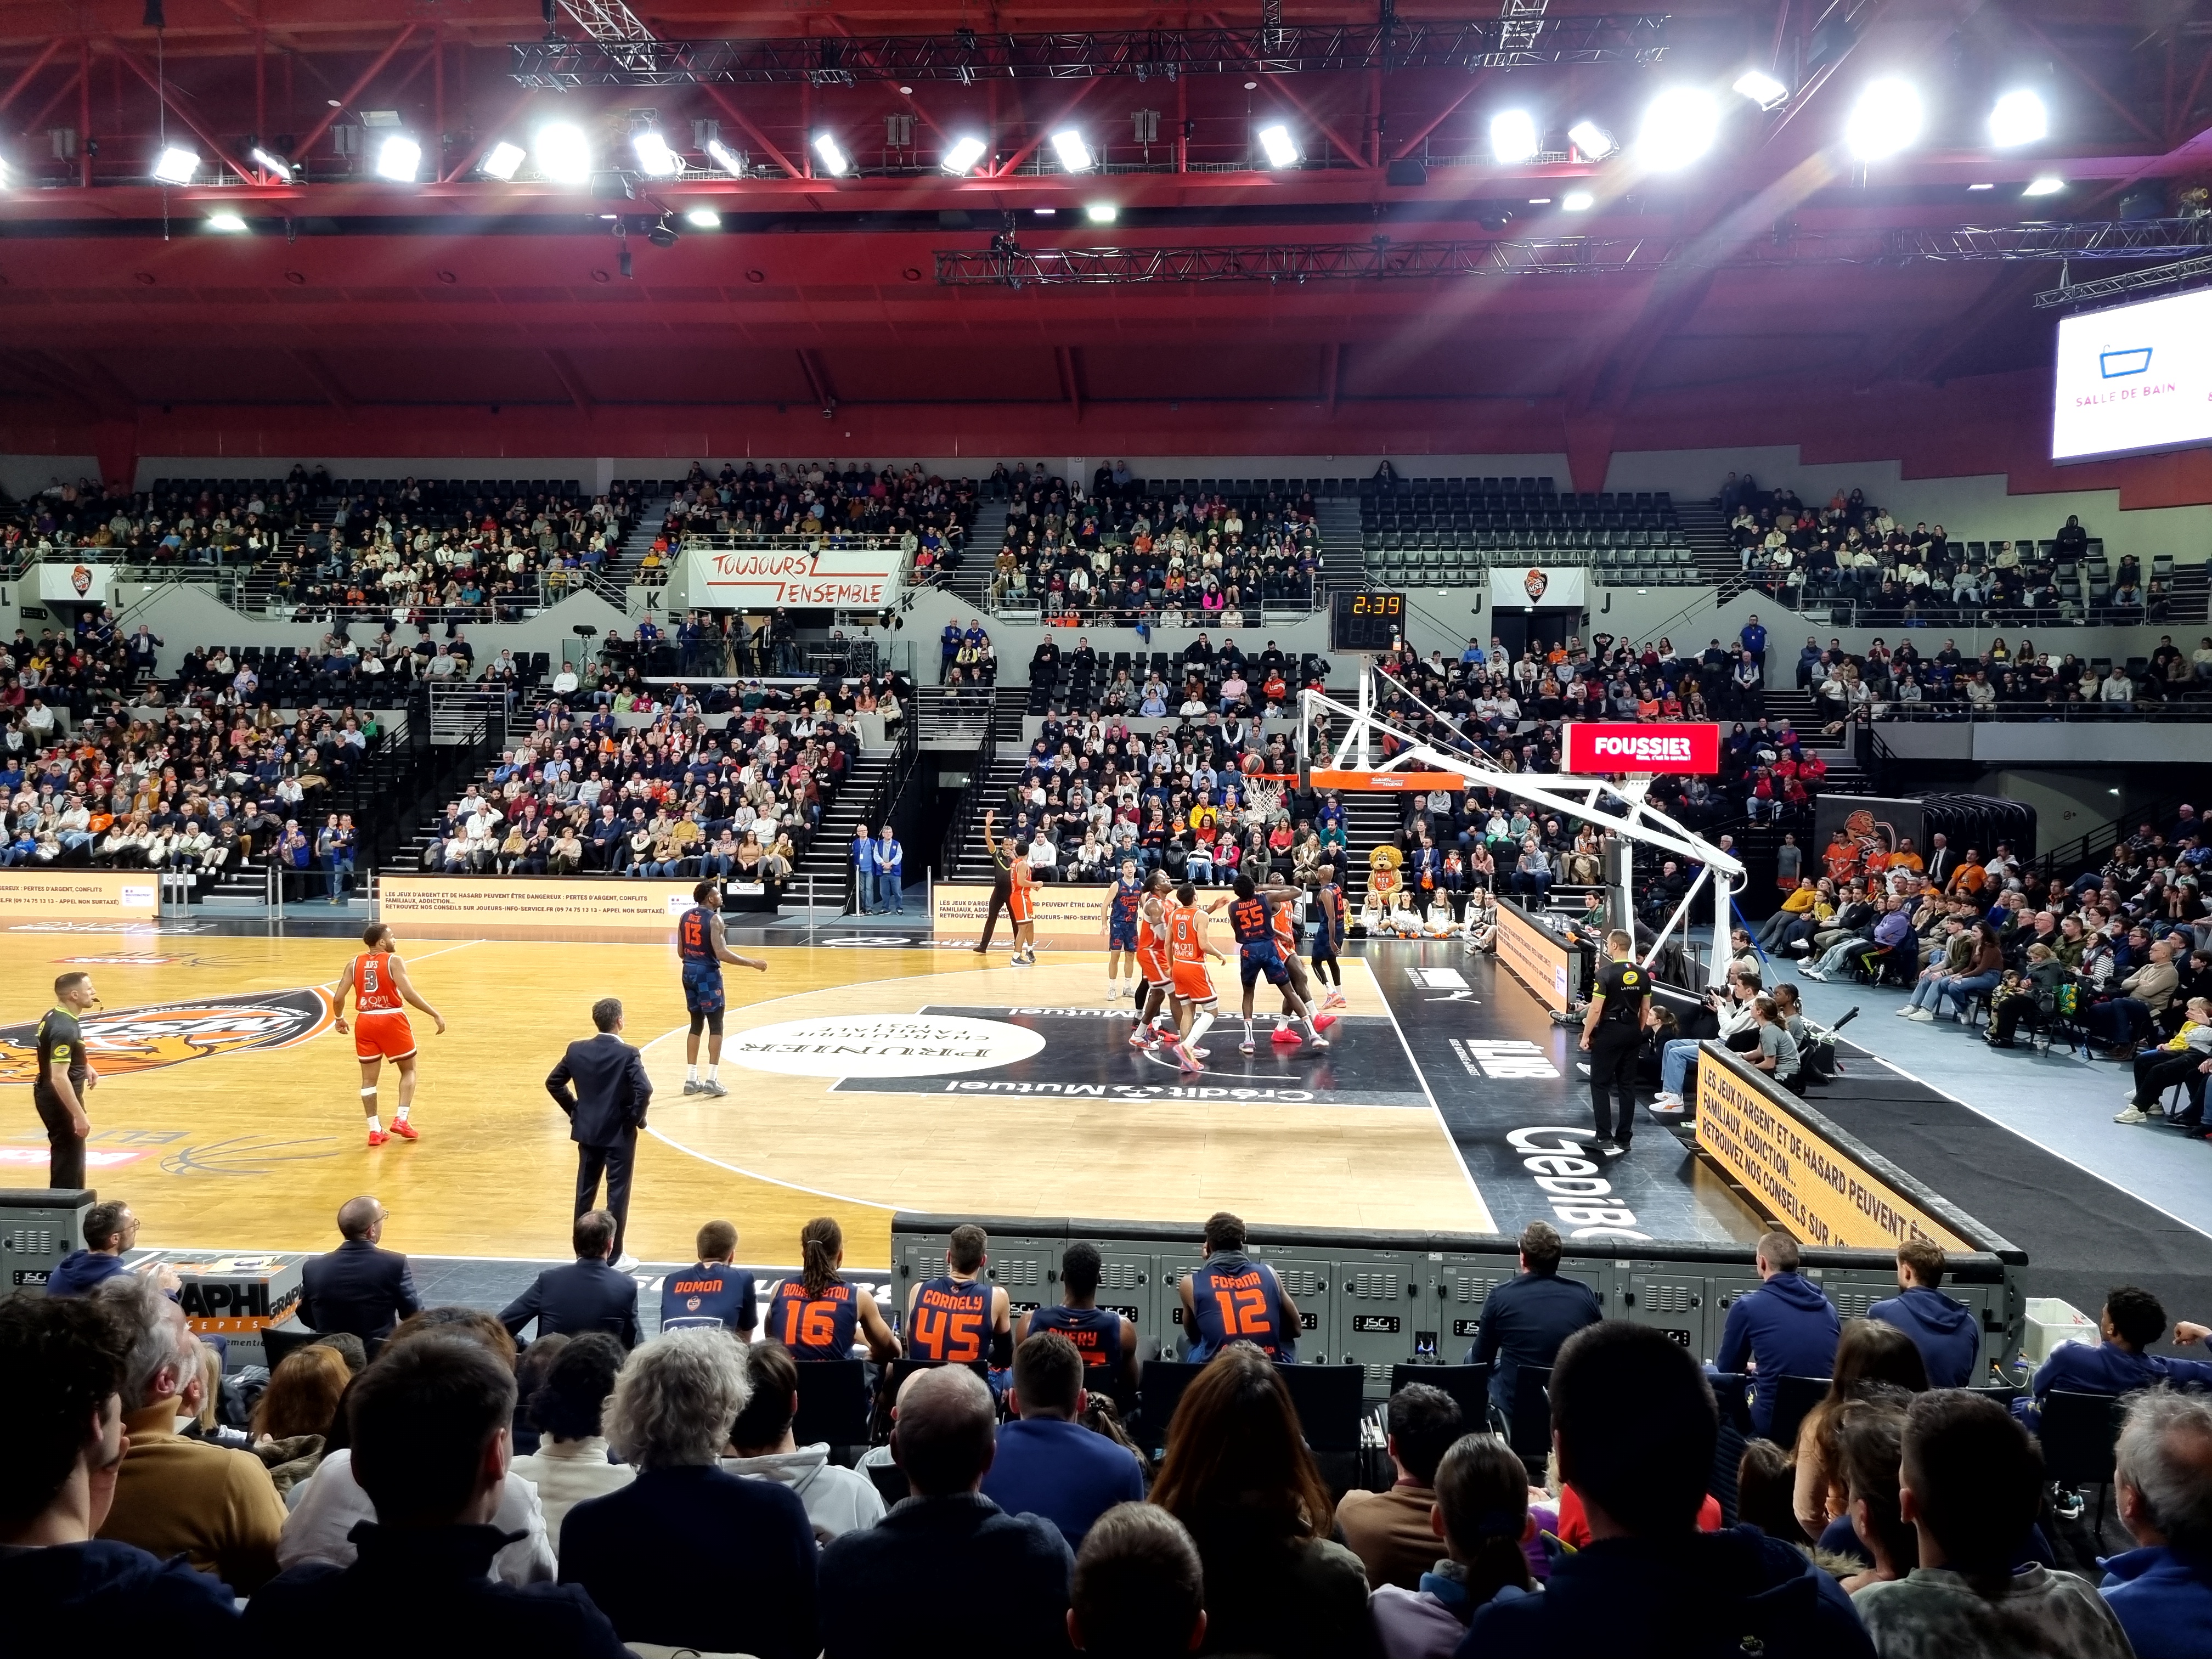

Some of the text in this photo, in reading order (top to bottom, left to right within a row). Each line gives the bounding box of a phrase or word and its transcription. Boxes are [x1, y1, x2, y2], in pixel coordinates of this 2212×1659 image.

[2076, 382, 2175, 407] SALLE DE BAIN
[712, 554, 808, 579] TOUJOURS
[76, 577, 89, 586] MSB
[1528, 582, 1544, 592] MSB
[1, 587, 10, 606] L
[115, 588, 124, 608] L
[647, 591, 661, 609] K
[788, 583, 884, 605] ENSEMBLE
[901, 592, 915, 612] K
[1471, 594, 1481, 614] J
[1600, 592, 1611, 614] J
[1354, 596, 1399, 613] 2:39
[1595, 737, 1691, 754] FOUSSIER
[1235, 905, 1264, 929] 35
[685, 922, 702, 945] 13
[1178, 922, 1186, 940] 9
[364, 970, 378, 992] 3
[792, 1031, 990, 1041] CHARCUTERIE
[821, 1026, 968, 1036] FAMILIALE
[740, 1043, 993, 1058] PRUNIER
[945, 1080, 1105, 1096] Mutuel
[1169, 1086, 1315, 1102] Crédit
[1703, 1091, 1742, 1143] FAMILIAUX,
[1704, 1066, 1717, 1091] LES
[1718, 1079, 1736, 1107] JEUX
[1737, 1091, 1775, 1133] D'ARGENT
[1777, 1122, 1788, 1148] ET
[1790, 1134, 1801, 1160] DE
[1804, 1142, 1846, 1195] HASARD
[1849, 1178, 1907, 1242] PEUVENT
[1702, 1116, 1829, 1246] RETROUVEZ NOS CONSEILS SUR
[674, 1279, 723, 1293] DOMON
[1210, 1272, 1261, 1290] FOFANA
[180, 1283, 269, 1318] APHI
[923, 1289, 983, 1311] CORNELY
[1216, 1289, 1271, 1335] 12
[1363, 1317, 1390, 1327] JSG
[187, 1319, 258, 1329] CEPTS
[785, 1300, 837, 1346] 16
[1464, 1322, 1480, 1332] JS
[916, 1307, 983, 1361] 45
